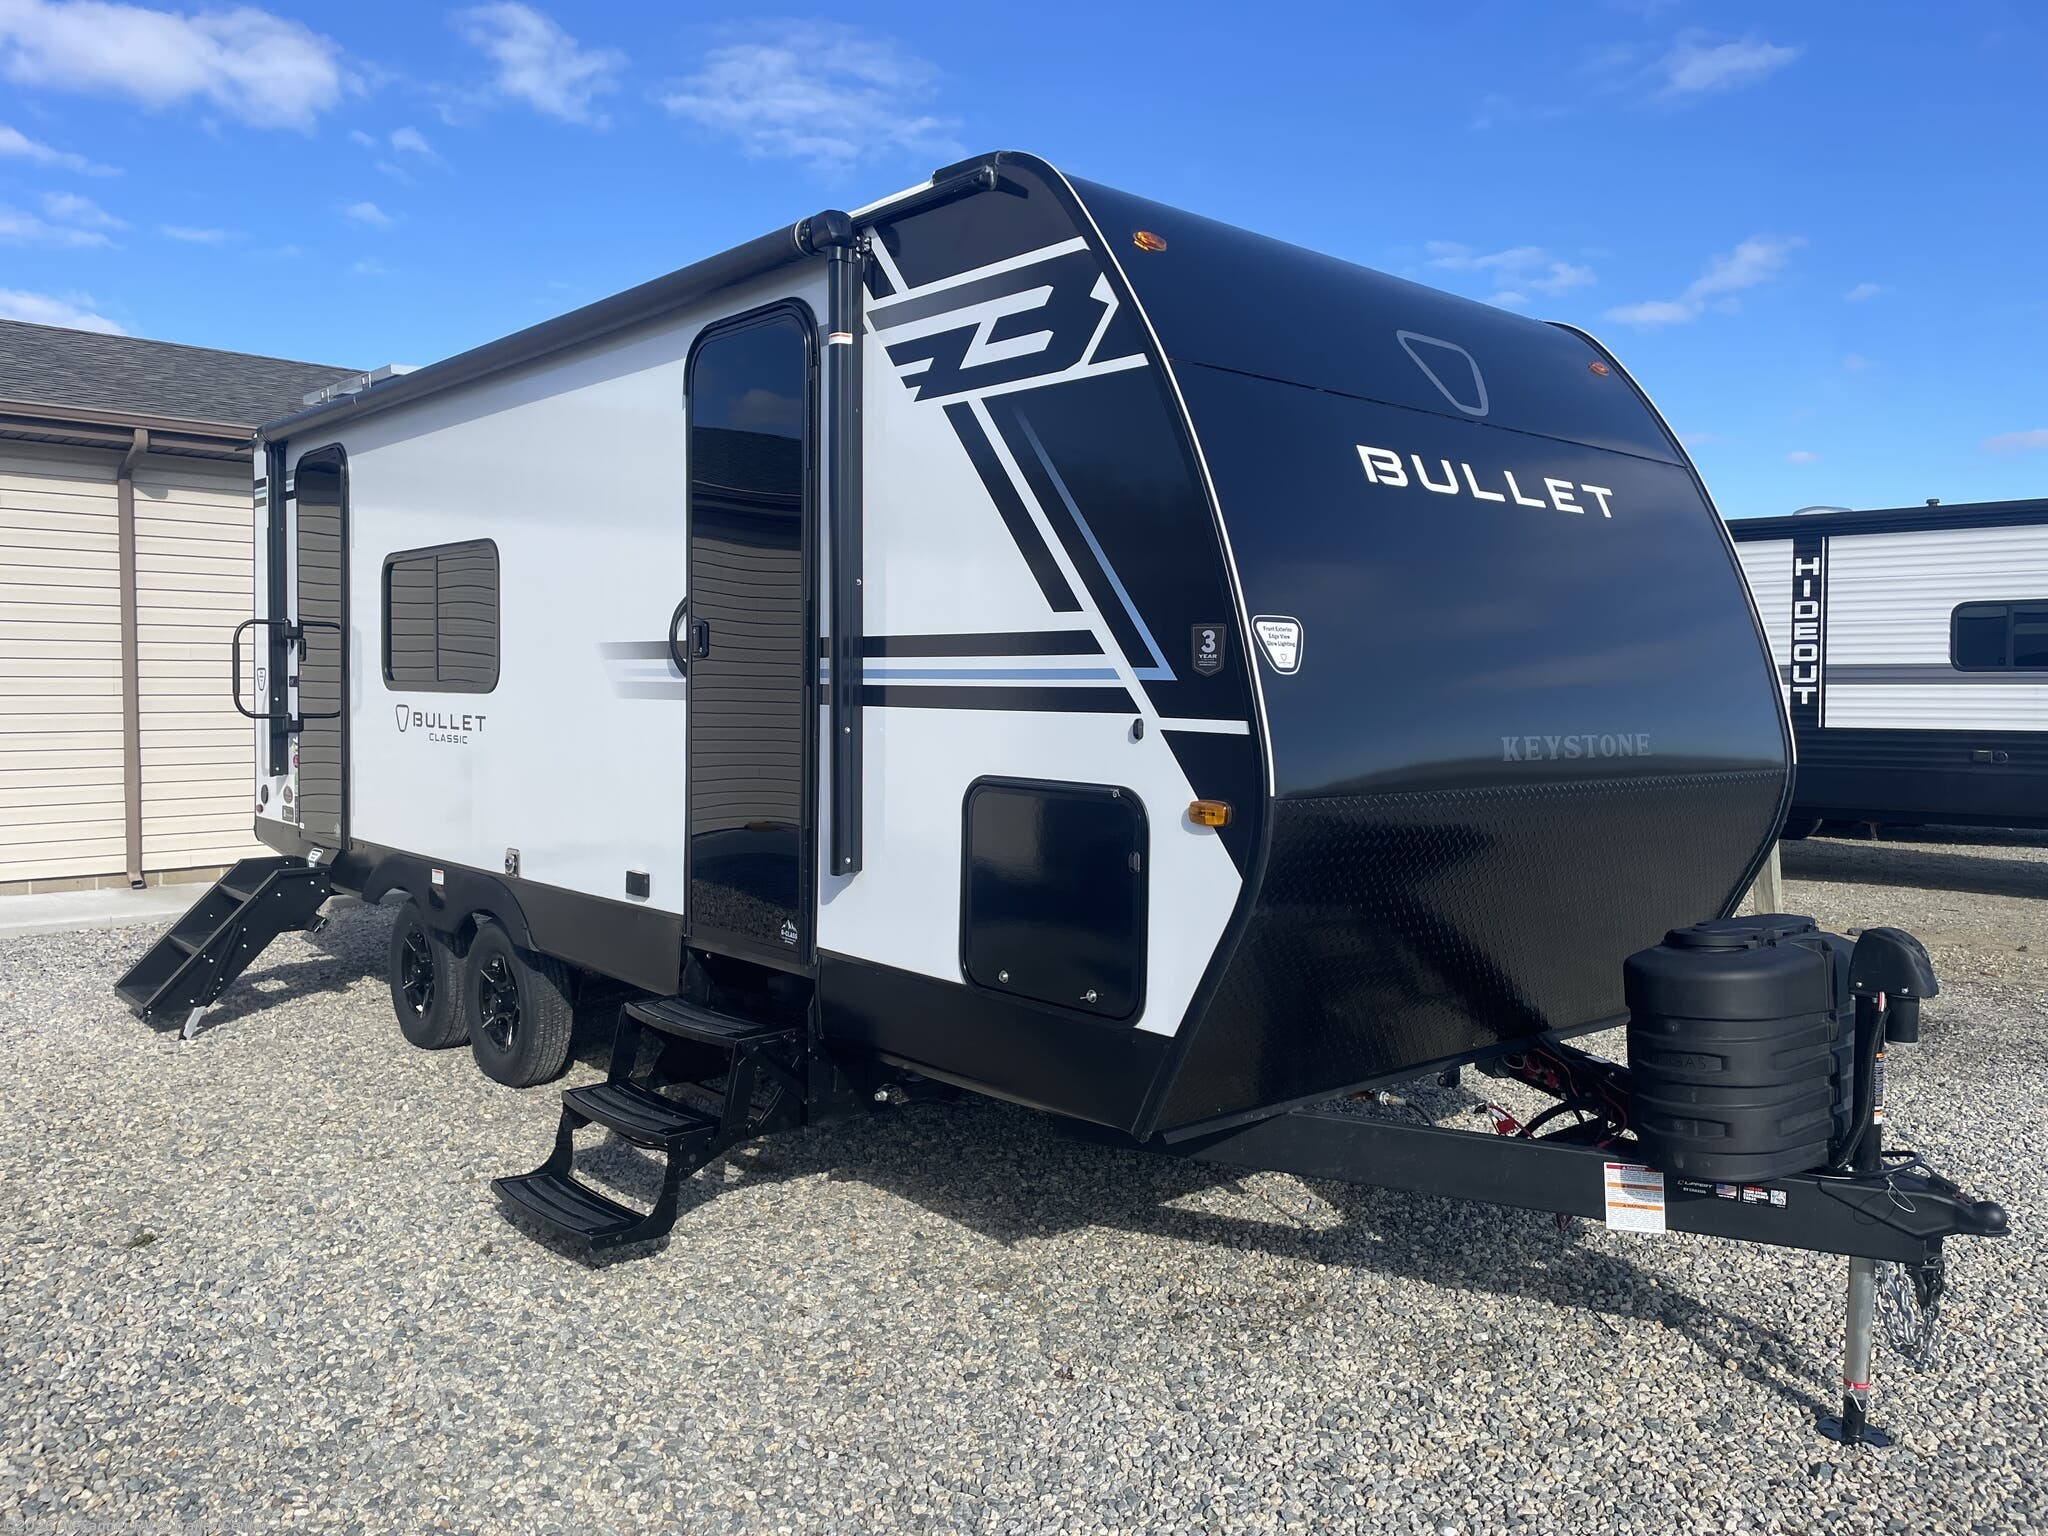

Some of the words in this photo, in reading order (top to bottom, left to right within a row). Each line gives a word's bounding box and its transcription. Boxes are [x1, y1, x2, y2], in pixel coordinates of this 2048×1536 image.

[1356, 444, 1613, 519] BULLET
[1201, 630, 1216, 653] 3
[1793, 557, 1820, 704] HIDEOUT
[413, 712, 486, 732] BULLET
[428, 732, 468, 745] CLASSIC
[1501, 733, 1653, 762] KEYSTONE
